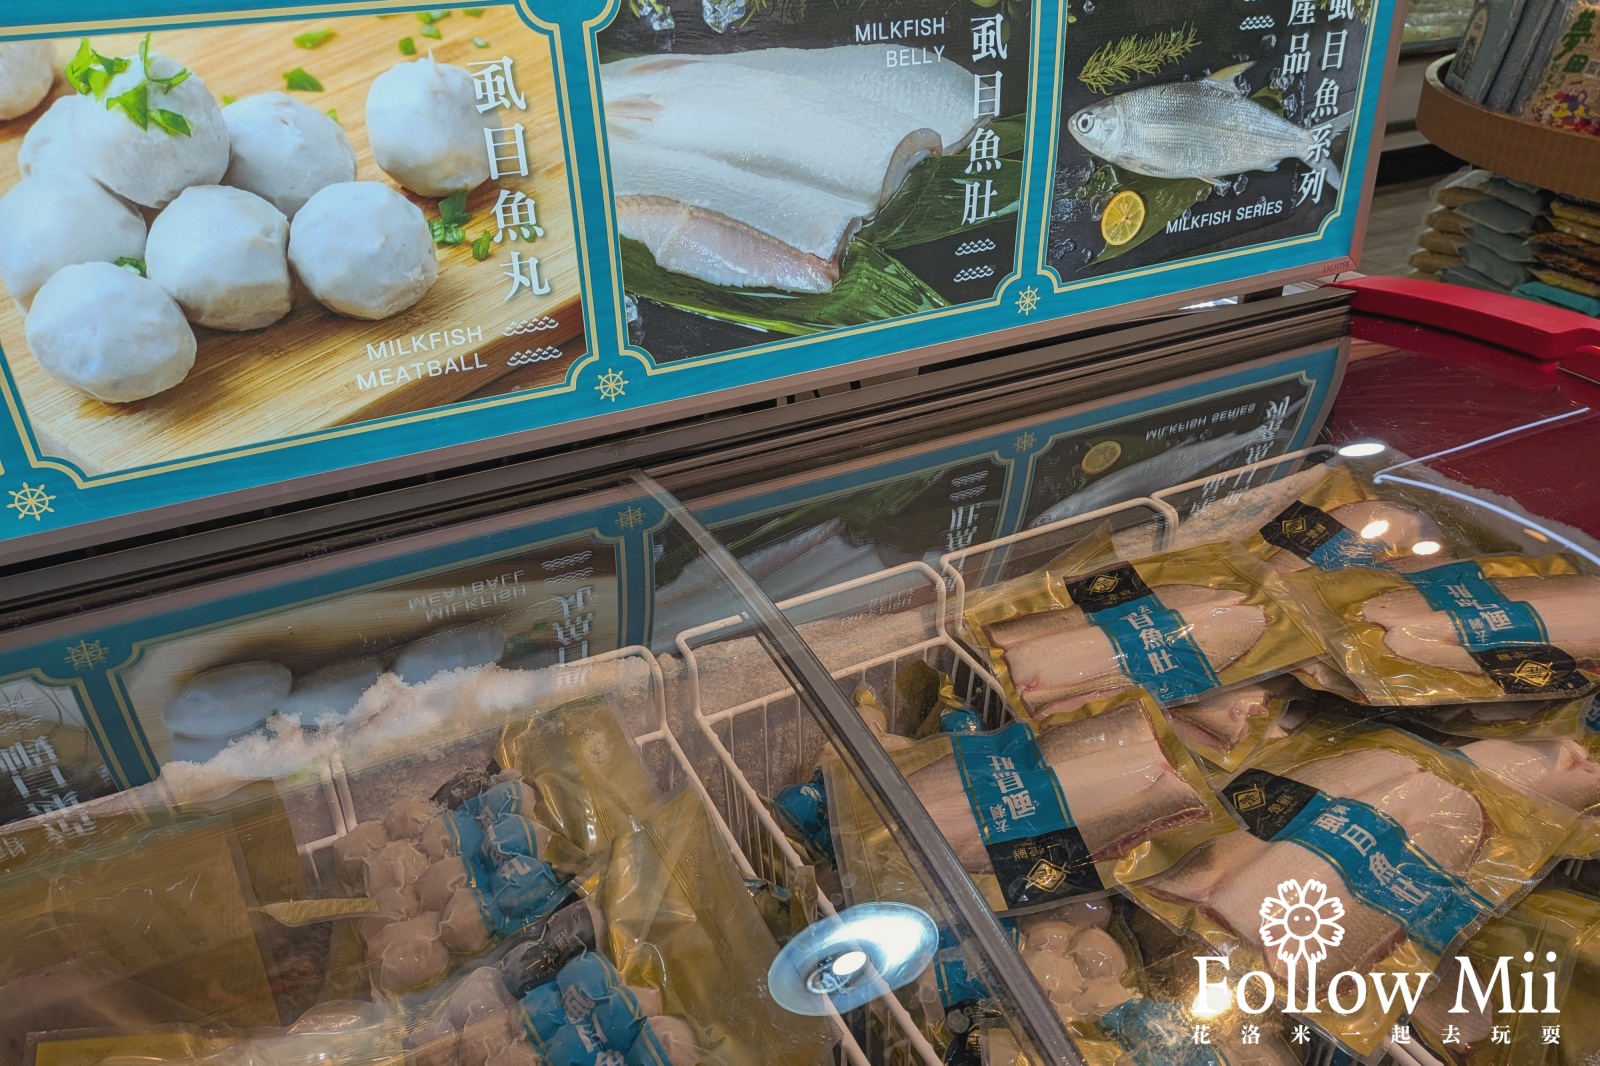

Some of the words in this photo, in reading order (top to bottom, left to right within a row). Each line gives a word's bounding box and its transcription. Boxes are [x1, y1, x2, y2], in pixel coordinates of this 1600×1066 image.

[854, 16, 946, 43] MILKFISH
[886, 45, 945, 69] BELLY
[961, 13, 1008, 226] 虱目魚肚
[466, 55, 552, 302] 虱目魚丸
[1165, 208, 1232, 235] MILKFISH
[1235, 200, 1284, 223] SERIES
[365, 324, 484, 361] MILKFISH
[355, 352, 488, 391] MEATBALL
